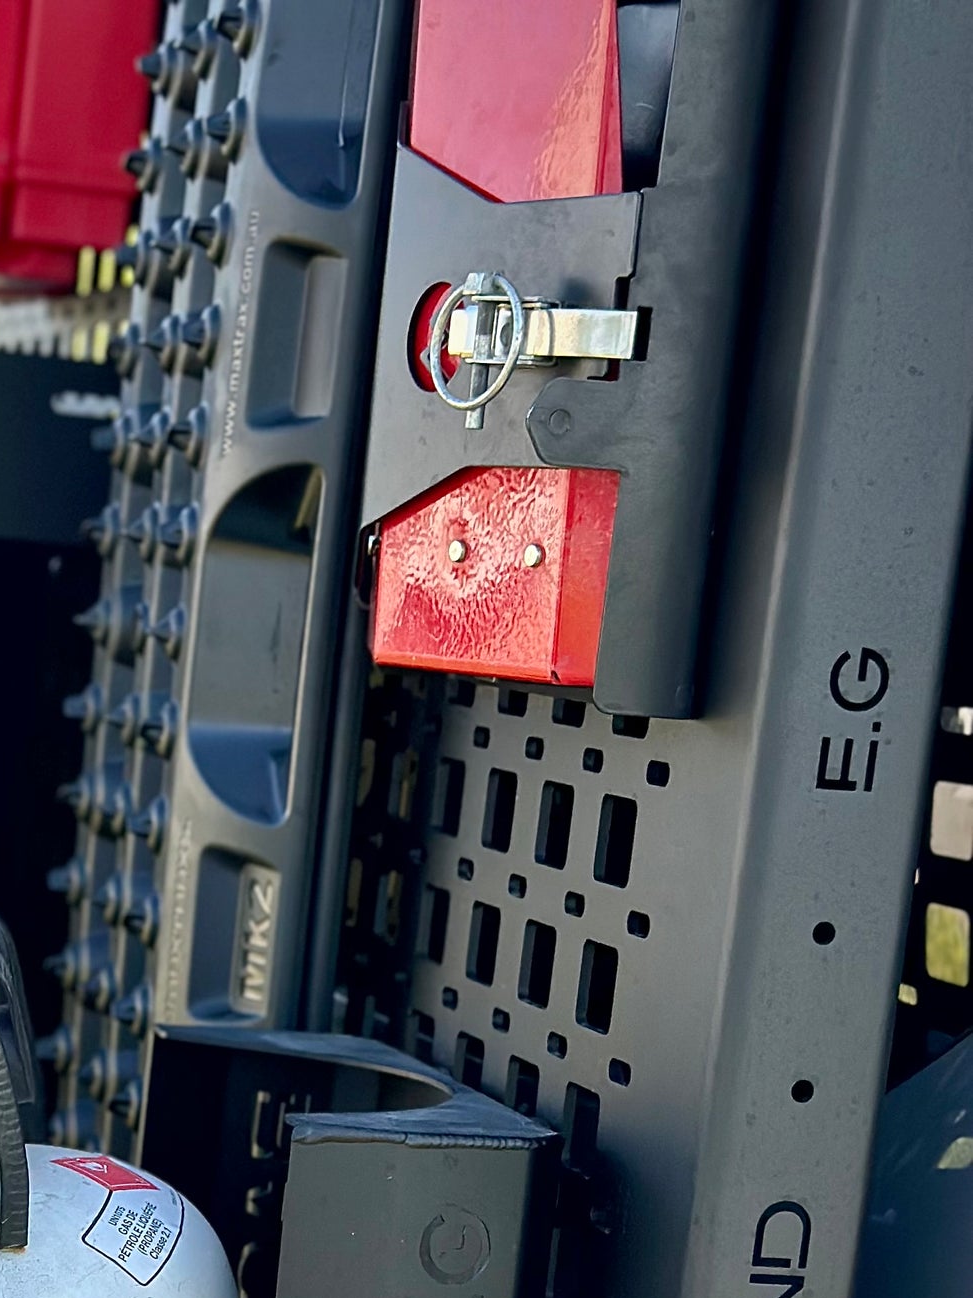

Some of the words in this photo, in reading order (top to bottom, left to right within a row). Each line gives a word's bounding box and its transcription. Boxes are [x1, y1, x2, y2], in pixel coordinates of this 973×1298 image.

[223, 210, 259, 455] www.maxtrax.com.au
[241, 878, 274, 1001] MK2
[118, 1218, 133, 1235] GAS
[118, 1226, 143, 1262] PÉTROLE
[149, 1236, 167, 1260] Classe
